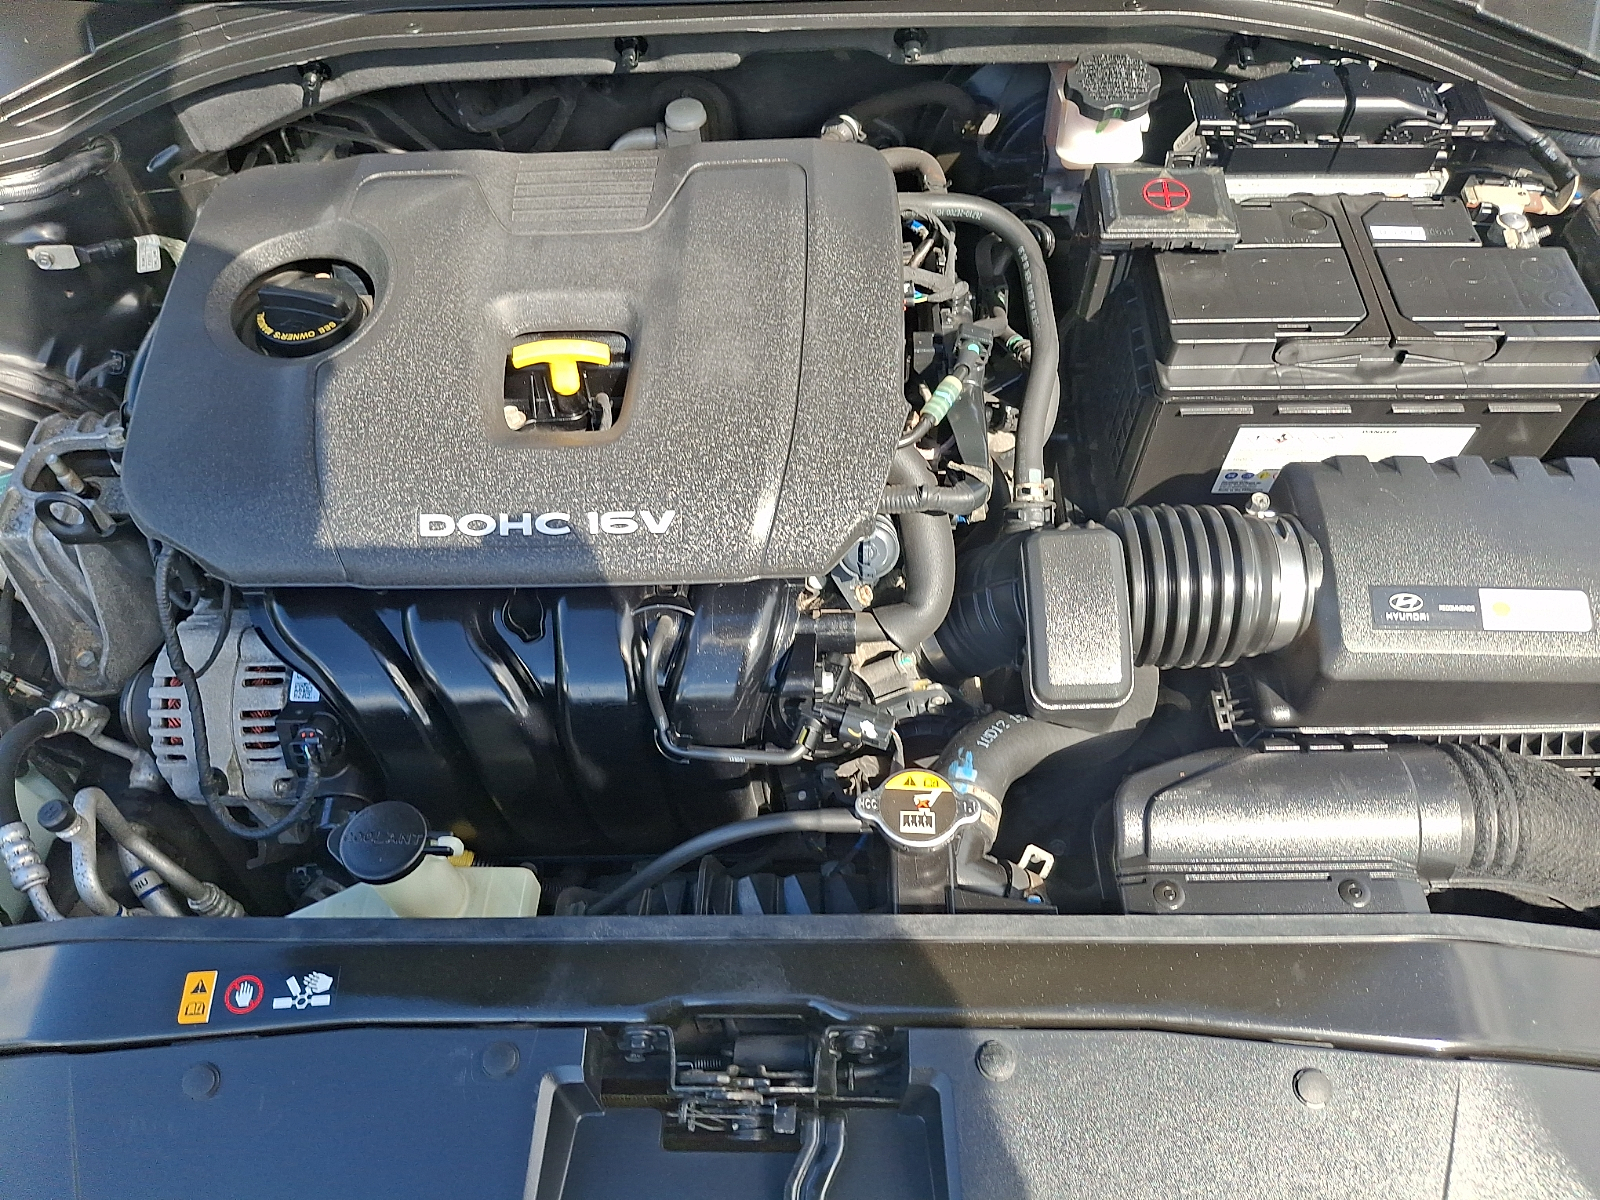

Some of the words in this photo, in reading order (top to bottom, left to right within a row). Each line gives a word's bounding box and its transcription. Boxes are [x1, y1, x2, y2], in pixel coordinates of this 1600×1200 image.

[318, 321, 337, 334] SEE
[420, 513, 571, 537] DOHC
[587, 510, 676, 535] 16V
[1385, 611, 1430, 622] HYUNDAI
[344, 830, 424, 846] COOLANT
